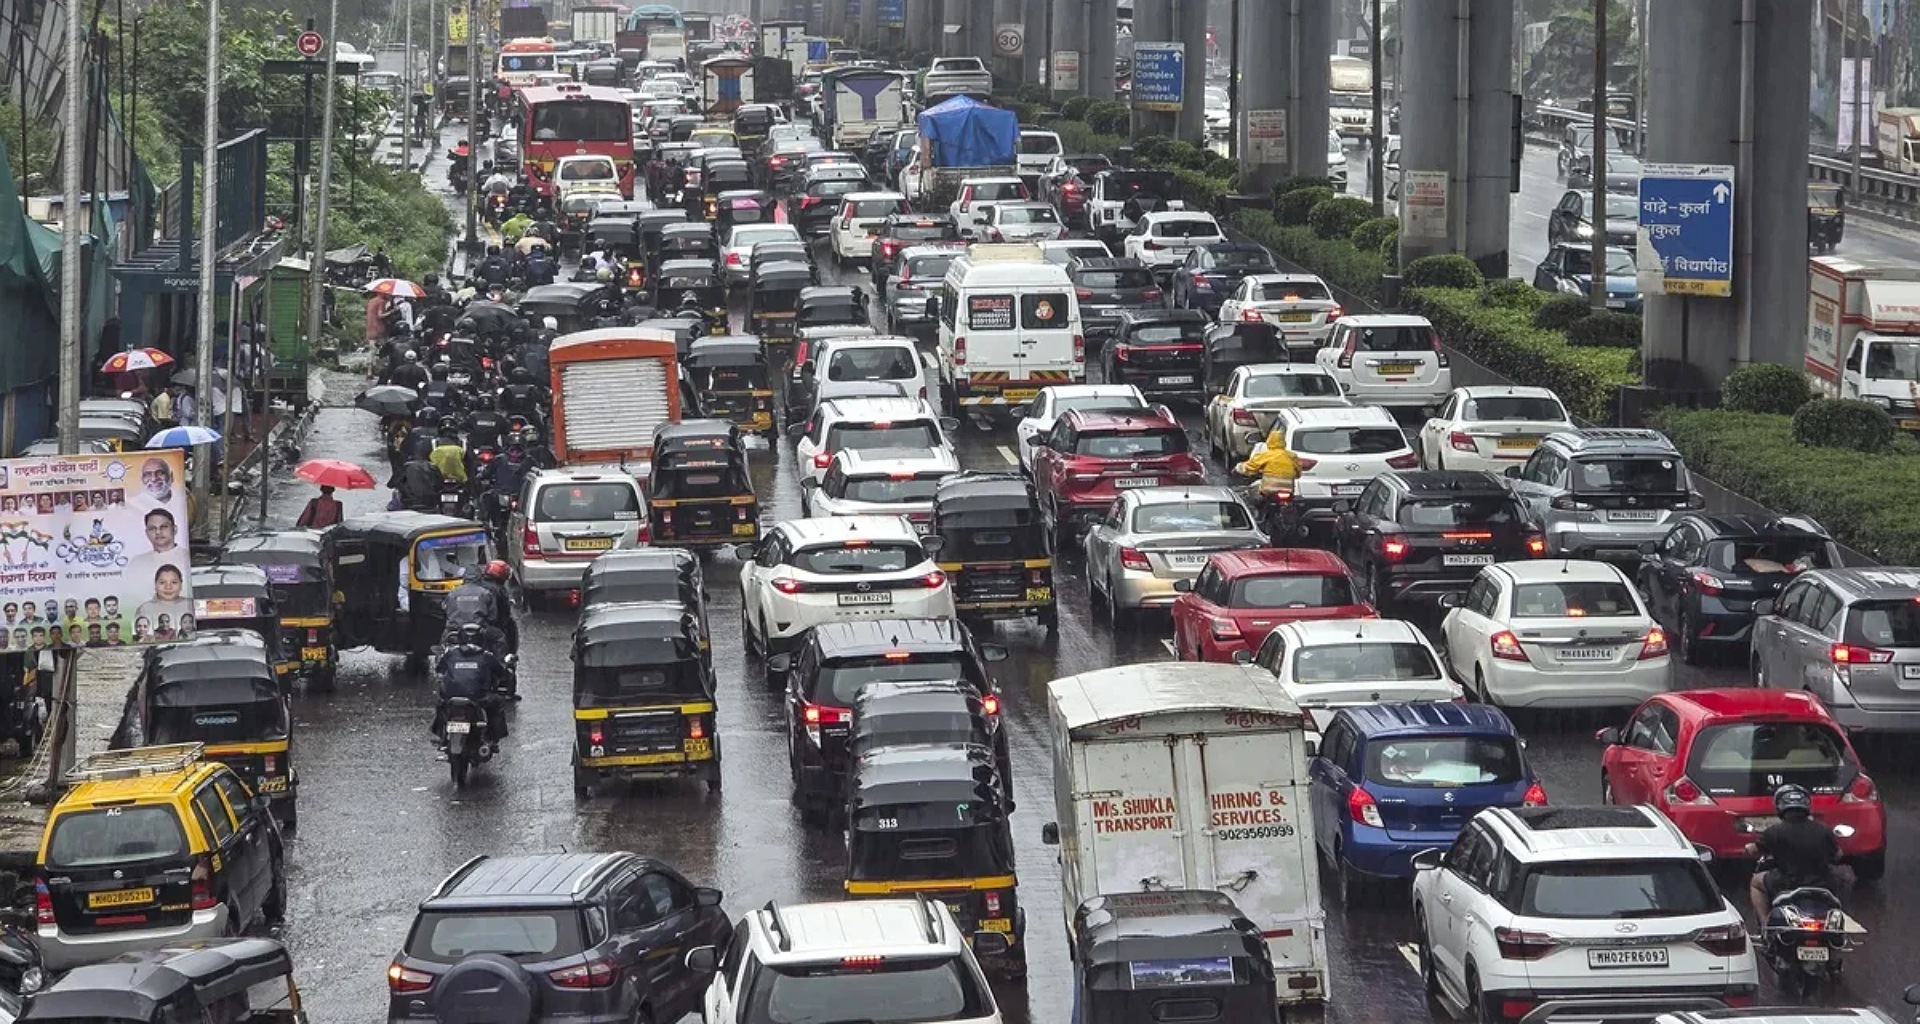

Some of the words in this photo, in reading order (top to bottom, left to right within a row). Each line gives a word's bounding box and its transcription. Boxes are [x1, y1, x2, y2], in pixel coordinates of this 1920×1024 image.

[1000, 34, 1018, 47] 30
[1136, 52, 1168, 60] Bandra
[1136, 61, 1159, 70] Kurla
[1136, 71, 1174, 79] Complex
[1211, 791, 1262, 810] HIRING
[1269, 789, 1287, 806] &
[106, 807, 122, 817] AC
[878, 818, 898, 829] 313
[1094, 815, 1173, 834] TRANSPORT
[1219, 825, 1294, 841] 9029560999
[1597, 950, 1666, 964] MH02FR6093
